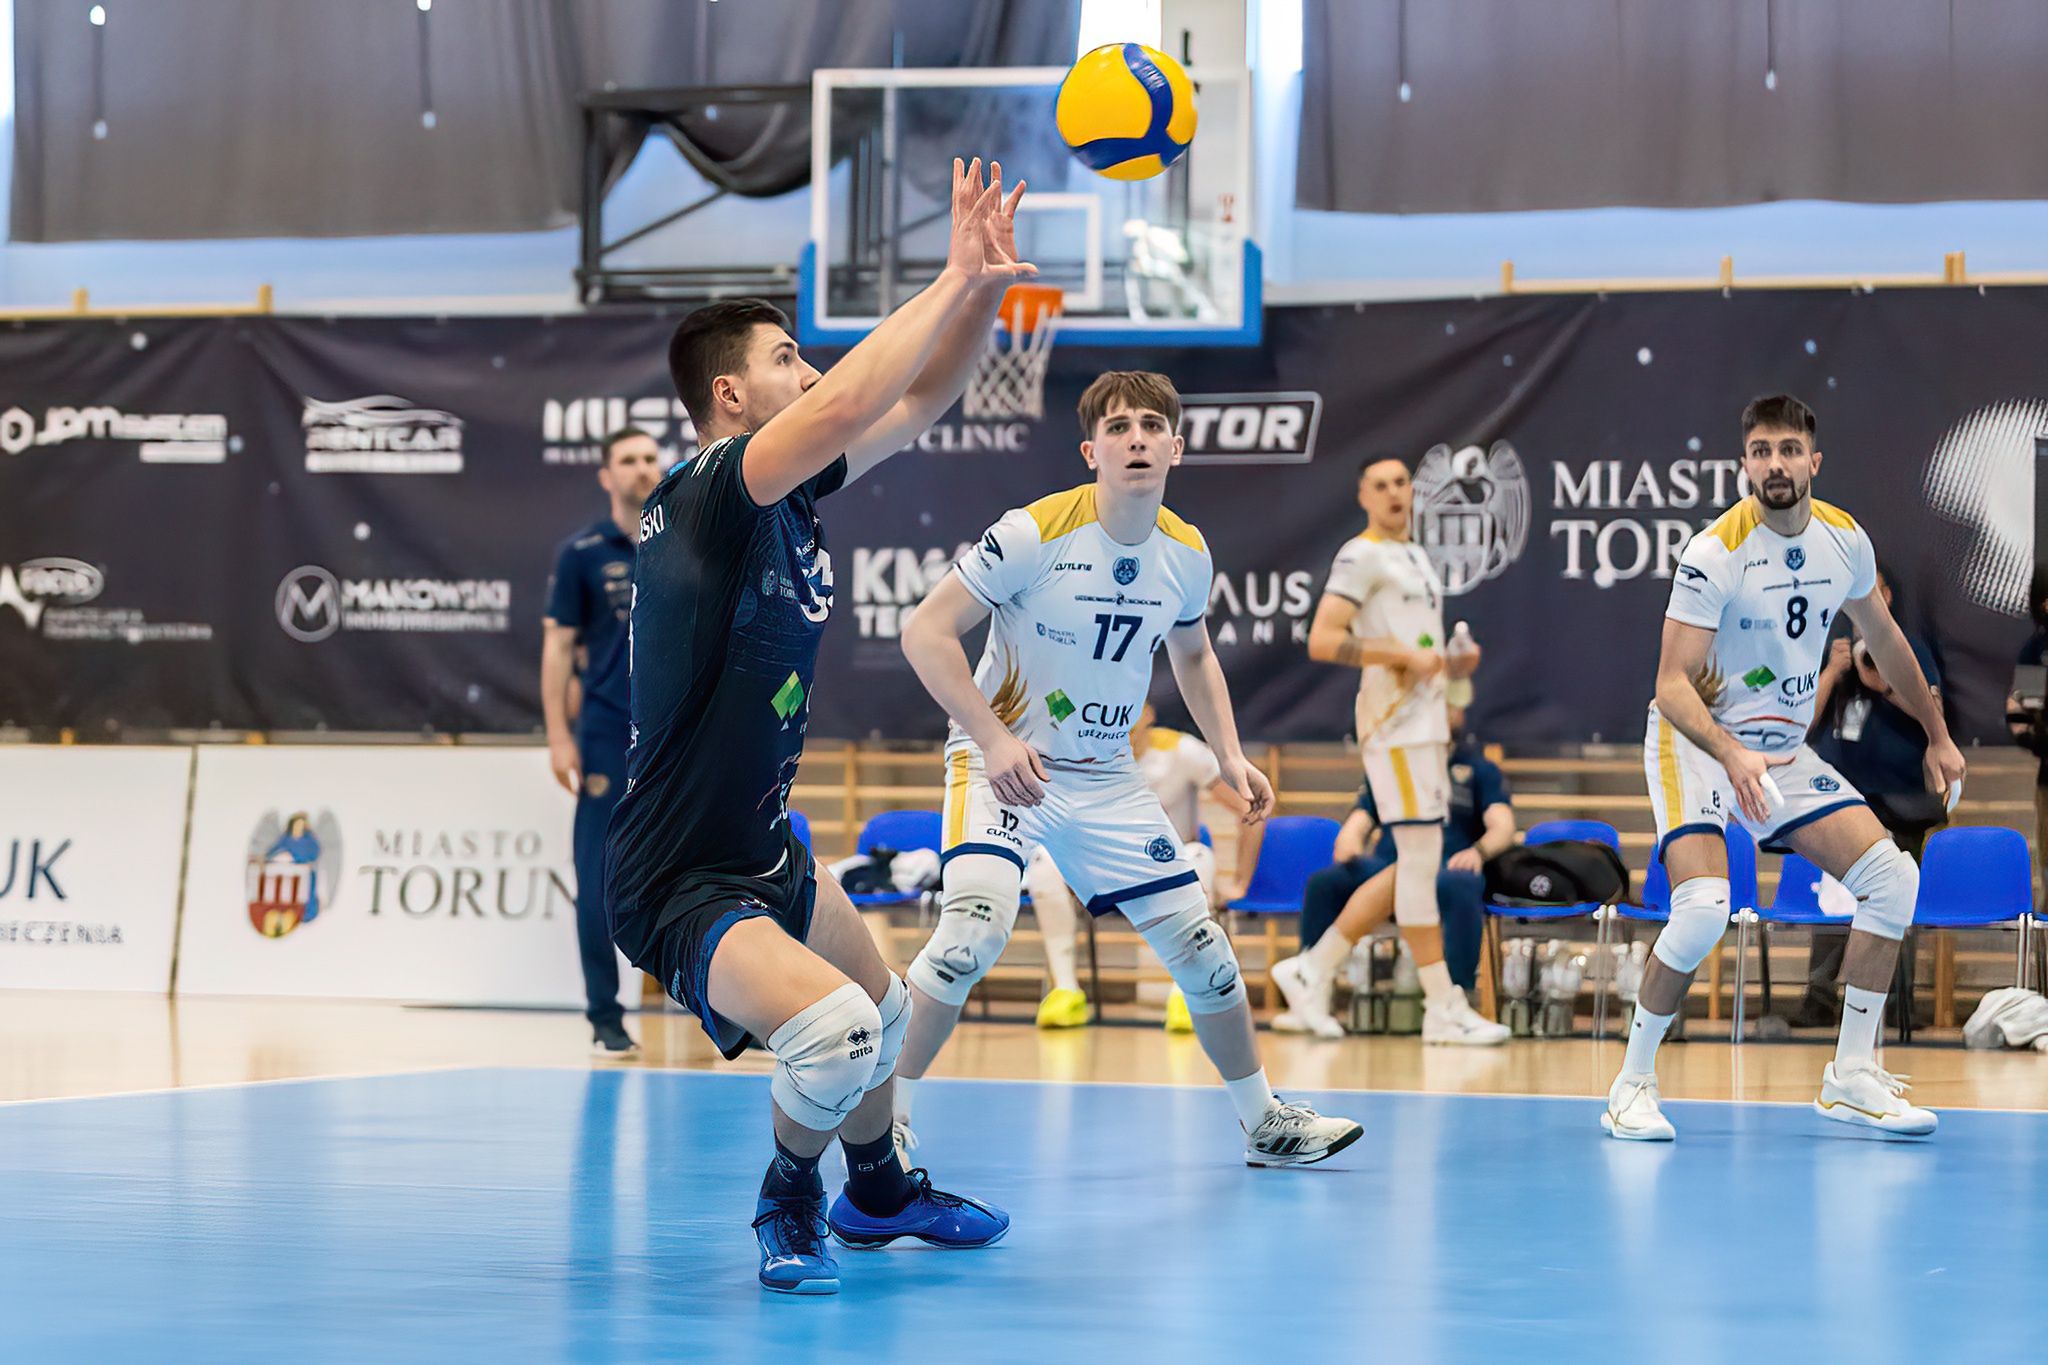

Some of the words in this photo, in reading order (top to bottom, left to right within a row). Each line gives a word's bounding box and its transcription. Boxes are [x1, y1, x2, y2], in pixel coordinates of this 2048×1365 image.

[918, 424, 1031, 451] CLINIC
[1182, 405, 1304, 450] TOR
[1551, 458, 1750, 509] MIAST
[639, 504, 665, 544] SKI
[1550, 518, 1712, 580] TOR
[1786, 595, 1809, 640] 8
[1093, 613, 1143, 663] 17
[1781, 671, 1817, 698] CUK
[1082, 702, 1135, 727] CUK
[1000, 808, 1020, 832] 17
[373, 829, 543, 860] MIASTO
